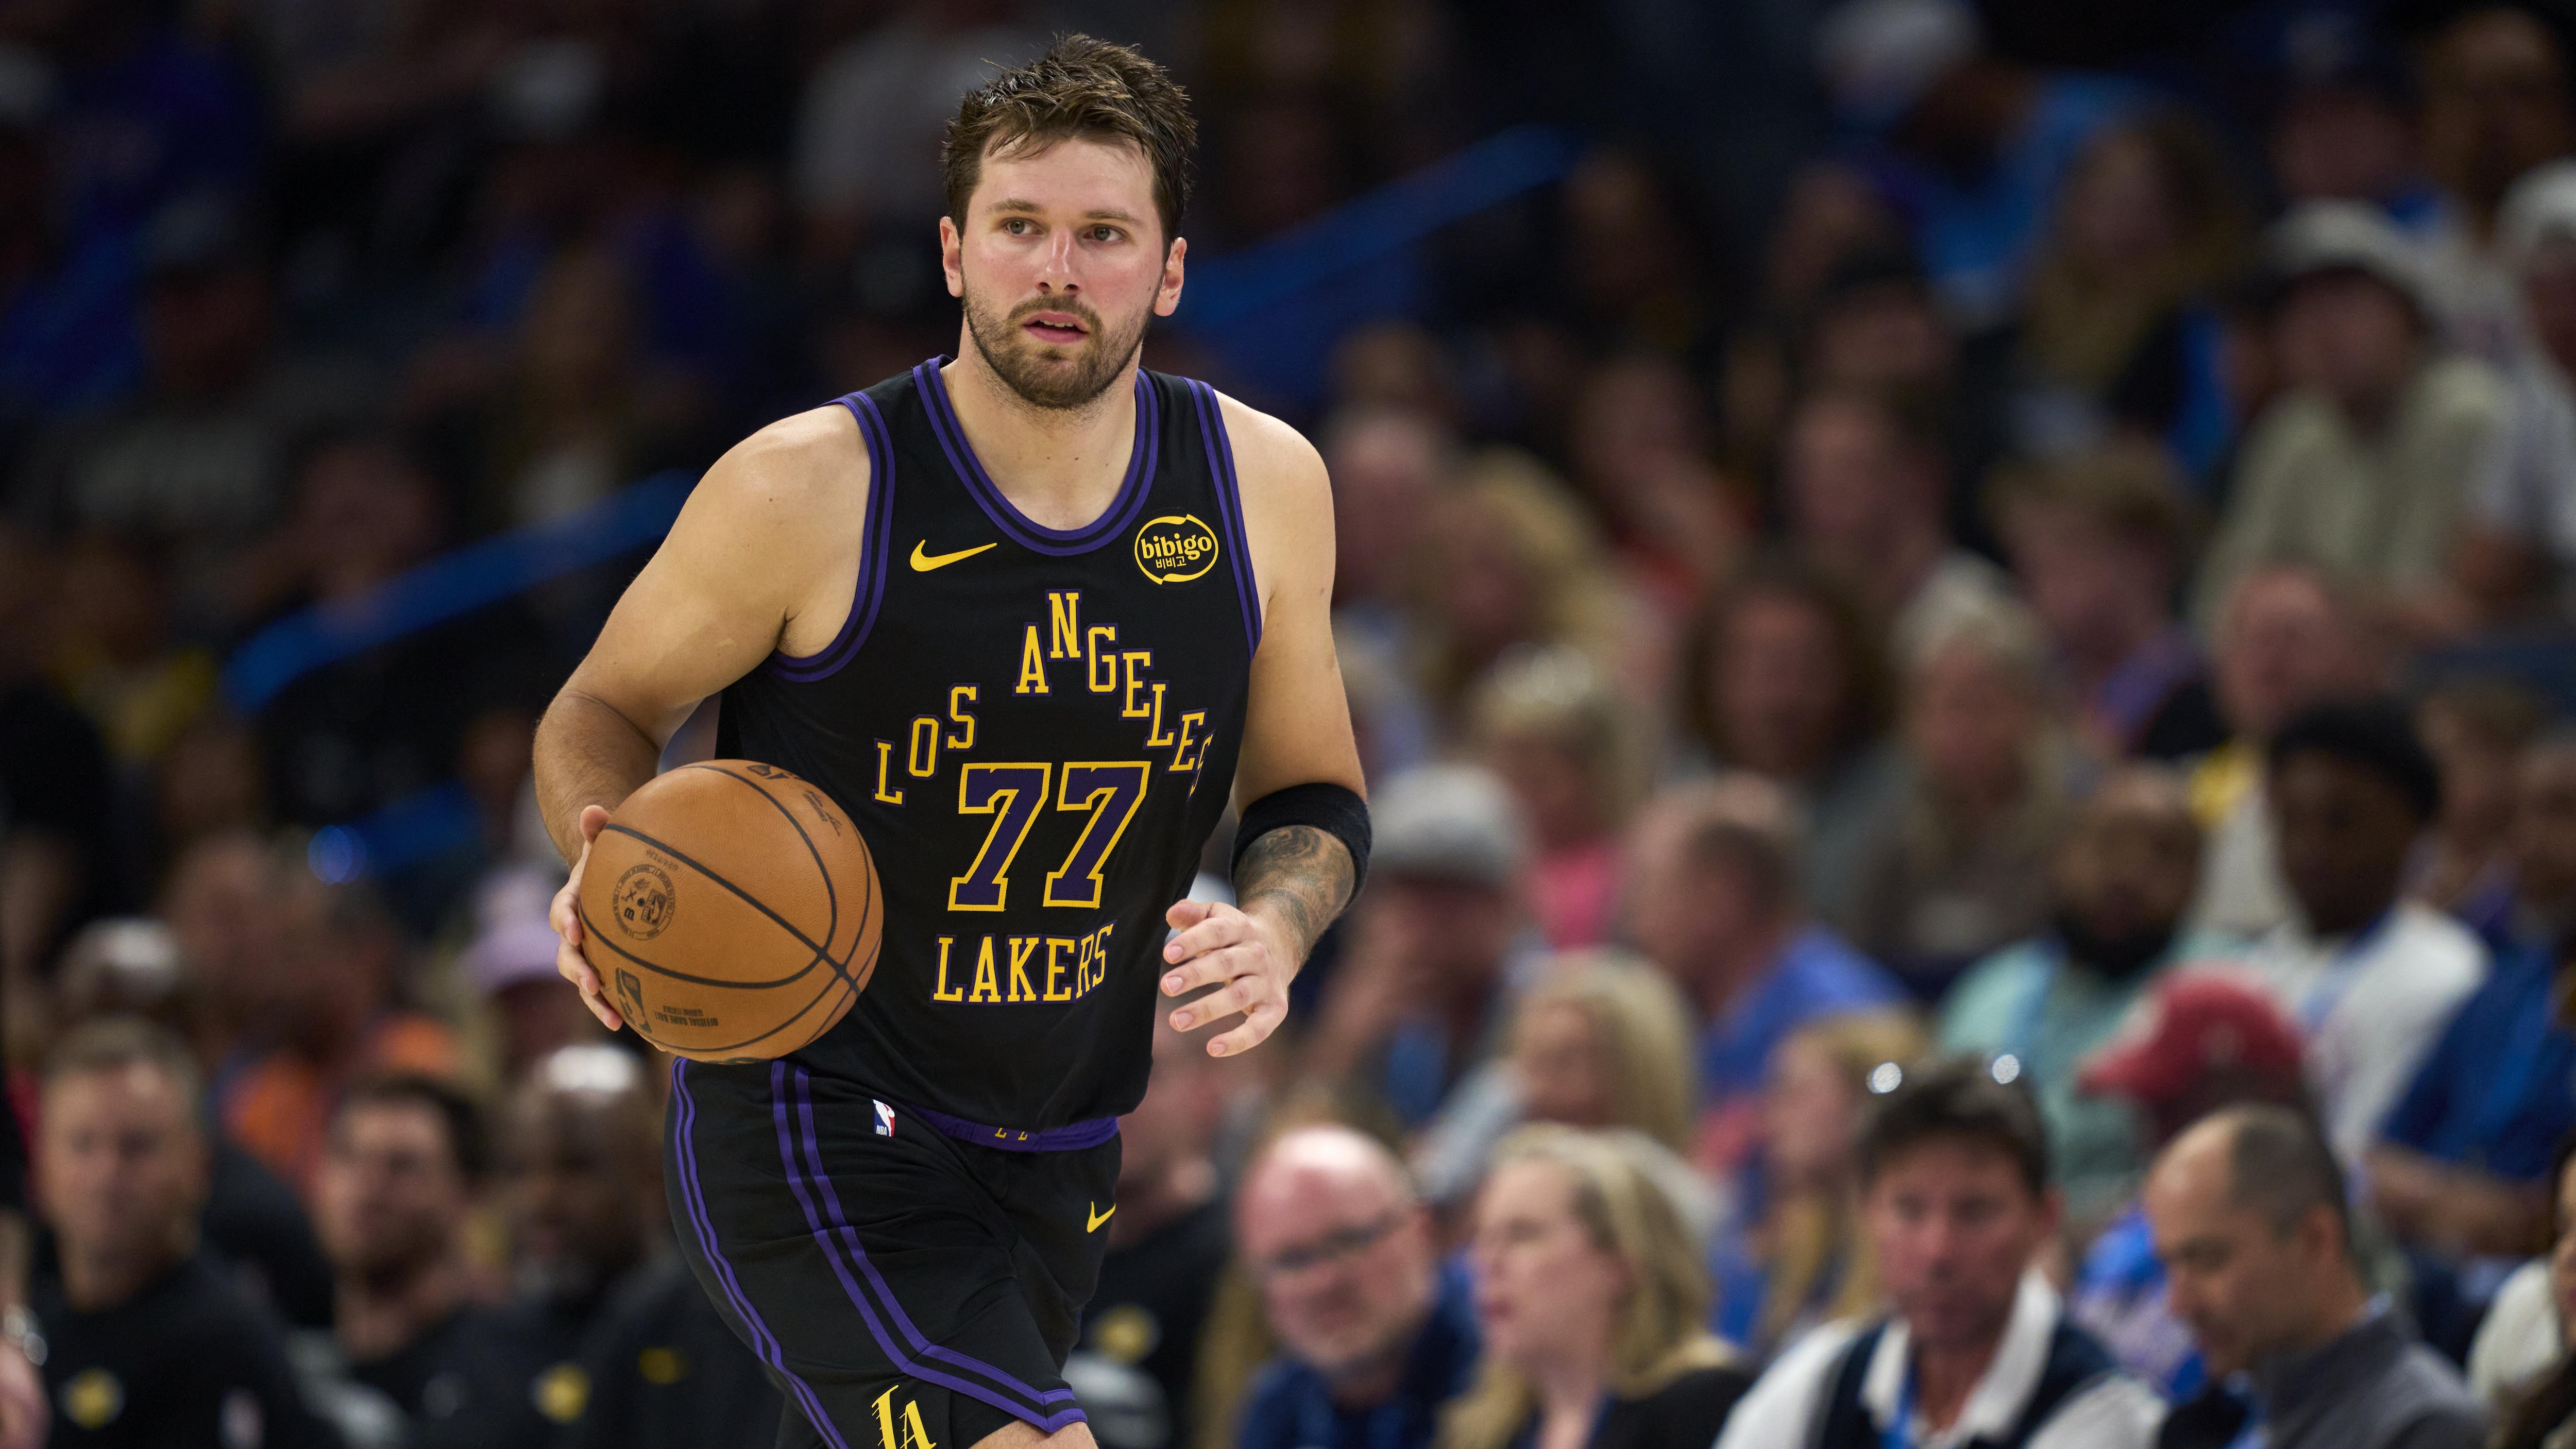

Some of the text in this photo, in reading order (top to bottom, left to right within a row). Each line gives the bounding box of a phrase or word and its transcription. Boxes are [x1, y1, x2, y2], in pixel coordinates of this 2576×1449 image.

[1141, 533, 1212, 560] bibigo
[1155, 556, 1187, 569] 비비고
[872, 589, 1216, 807] LOS ANGELES
[947, 761, 1151, 912] 77
[929, 920, 1117, 1004] LAKERS
[876, 1124, 887, 1136] NBA
